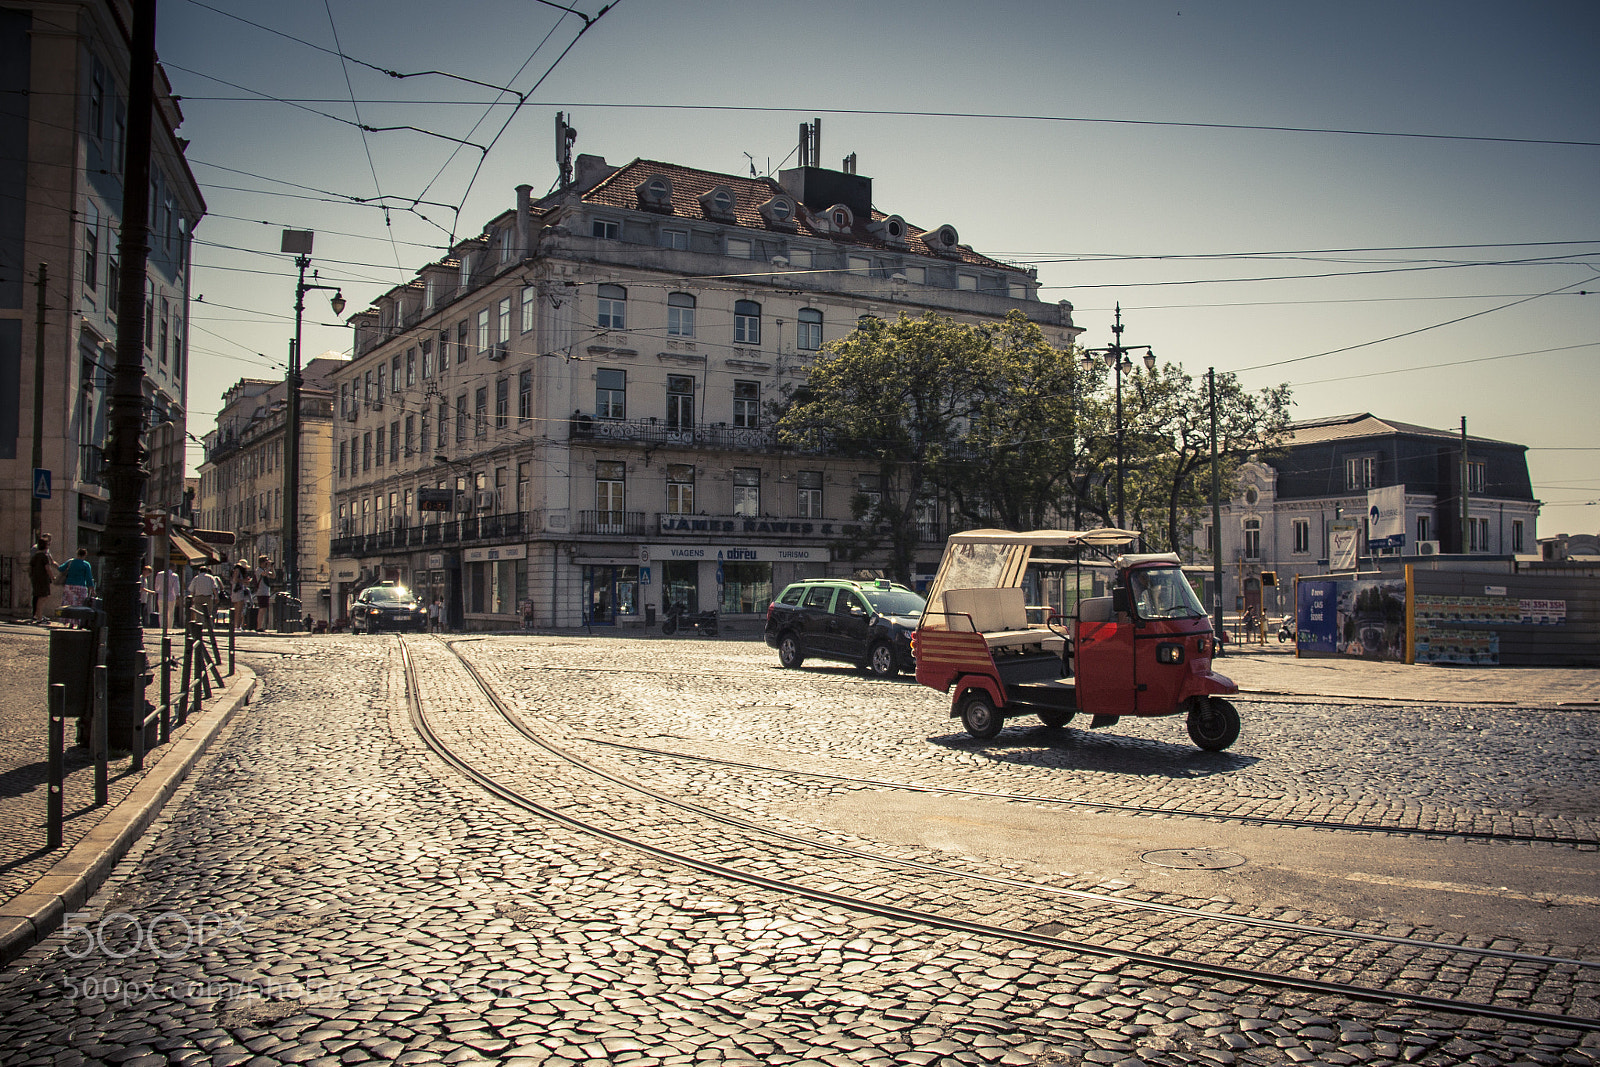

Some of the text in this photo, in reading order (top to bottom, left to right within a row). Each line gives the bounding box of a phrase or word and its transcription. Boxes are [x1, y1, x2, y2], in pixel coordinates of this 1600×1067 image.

[662, 519, 734, 532] JAMES
[743, 521, 813, 534] RAWES
[671, 547, 809, 560] VIAGENS abreu TURISMO
